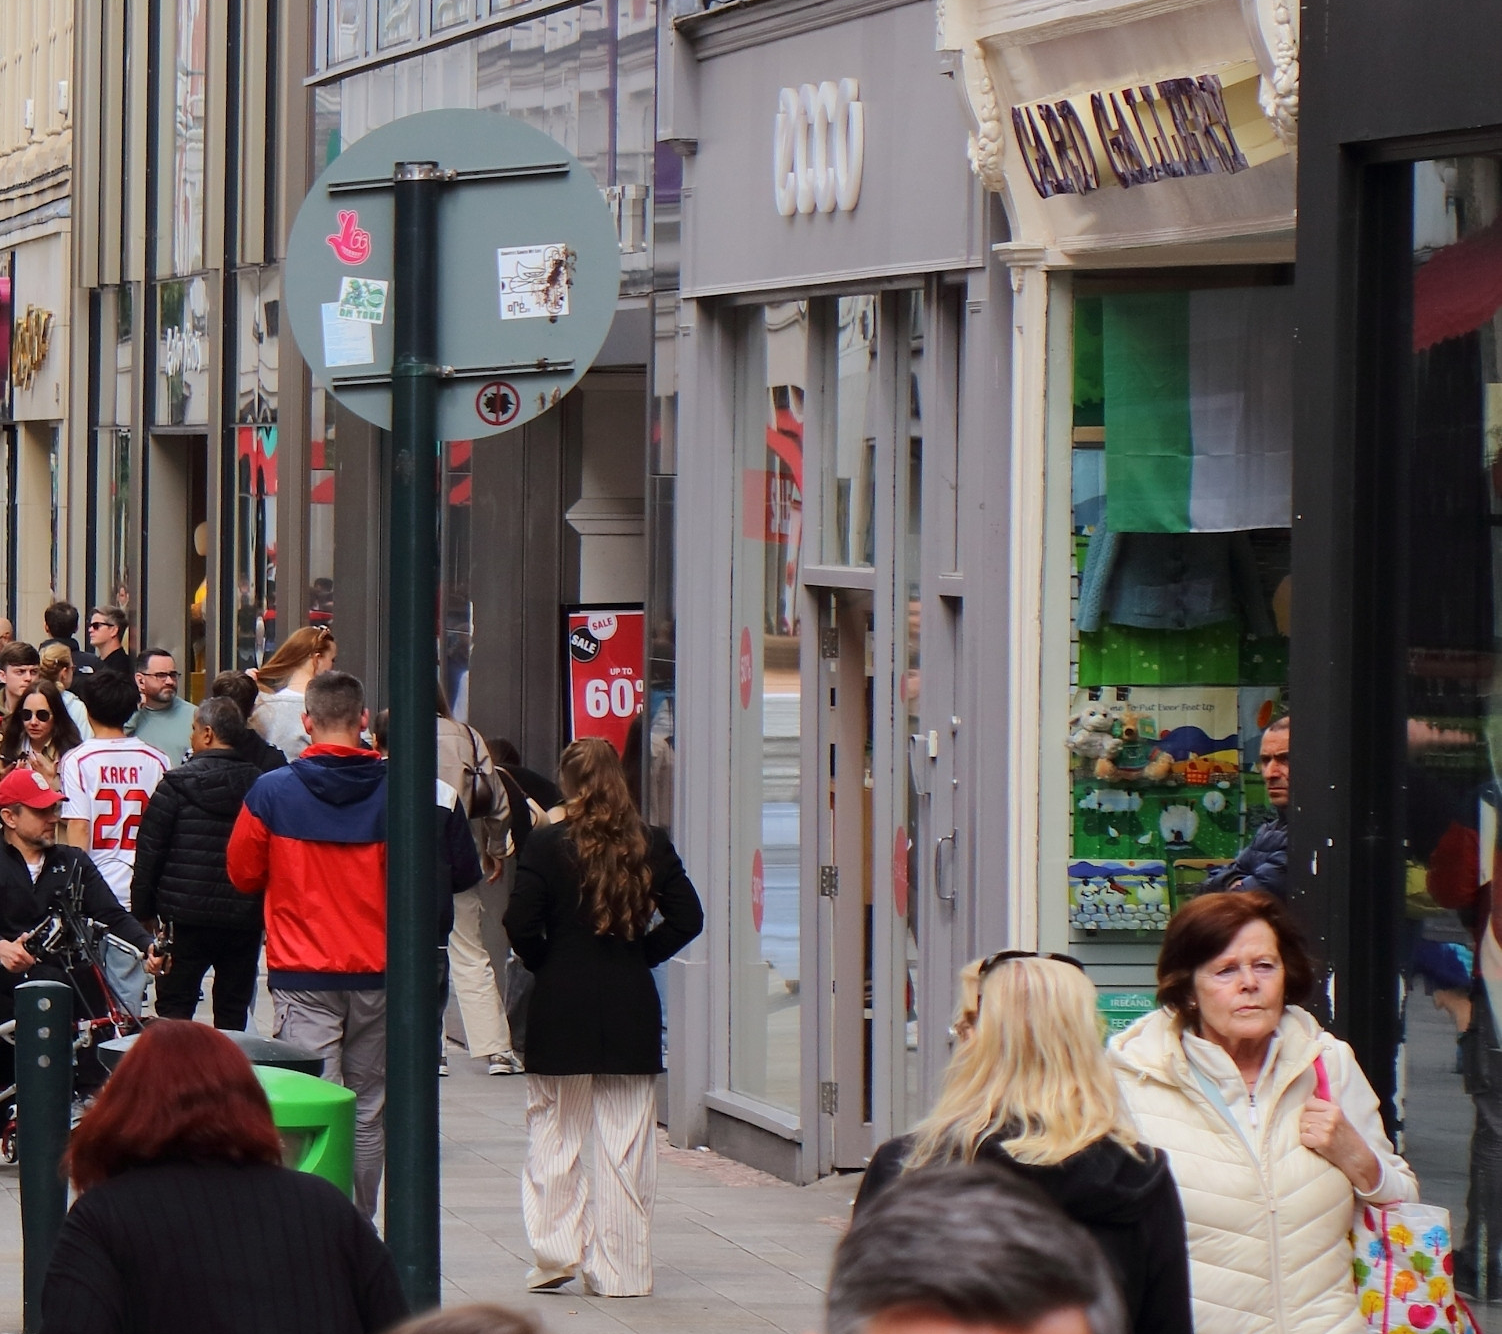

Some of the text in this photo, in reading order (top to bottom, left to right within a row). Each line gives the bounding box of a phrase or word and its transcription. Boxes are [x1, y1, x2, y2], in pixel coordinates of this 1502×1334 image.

[1012, 74, 1250, 200] CARD GALLERY
[592, 617, 614, 631] SALE
[571, 634, 597, 655] SALE
[610, 667, 633, 676] UP TO
[1139, 703, 1156, 711] Put
[1181, 703, 1200, 711] Feet
[1202, 703, 1215, 713] Up
[93, 789, 151, 850] 22
[1110, 999, 1152, 1007] IRELAND
[1112, 1018, 1130, 1027] FEC
